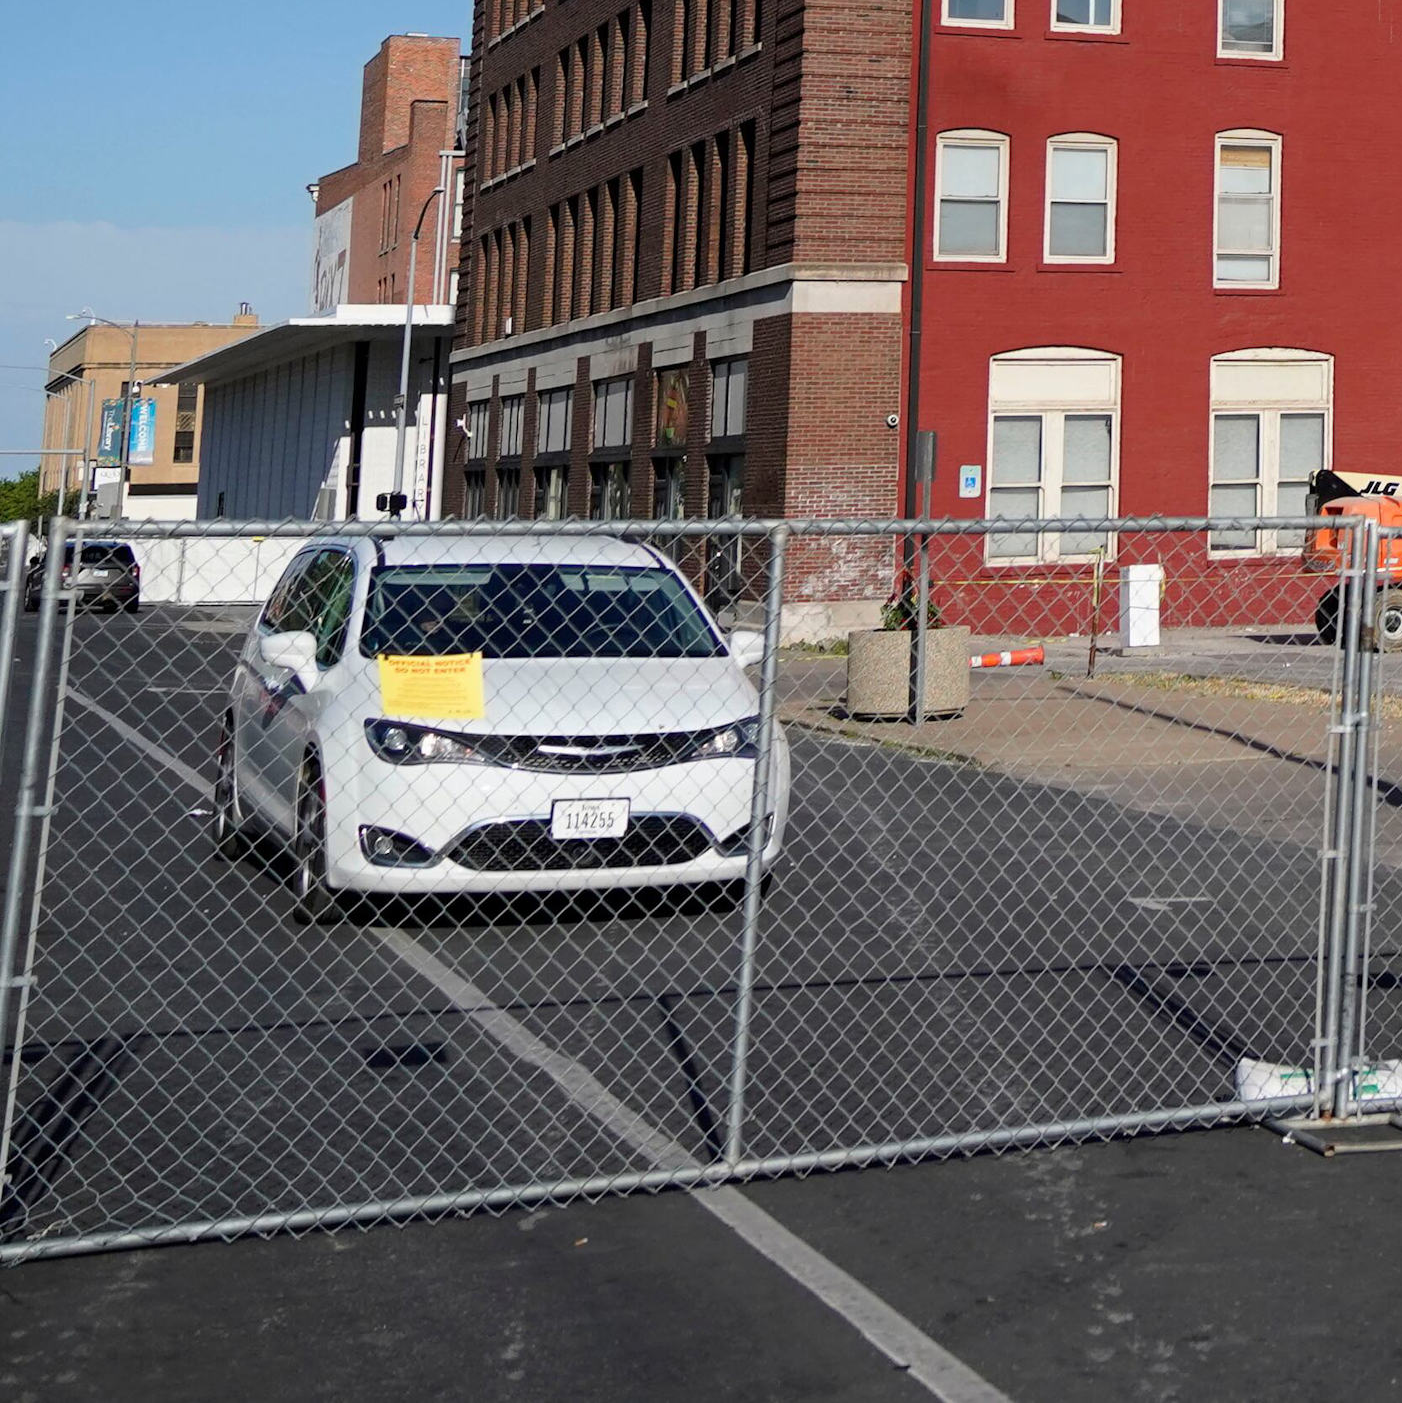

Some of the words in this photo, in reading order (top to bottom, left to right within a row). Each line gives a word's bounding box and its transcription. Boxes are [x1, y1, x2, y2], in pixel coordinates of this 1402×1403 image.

[417, 415, 429, 510] LIBRARY
[1360, 480, 1400, 496] JLG
[566, 811, 615, 830] 114255
